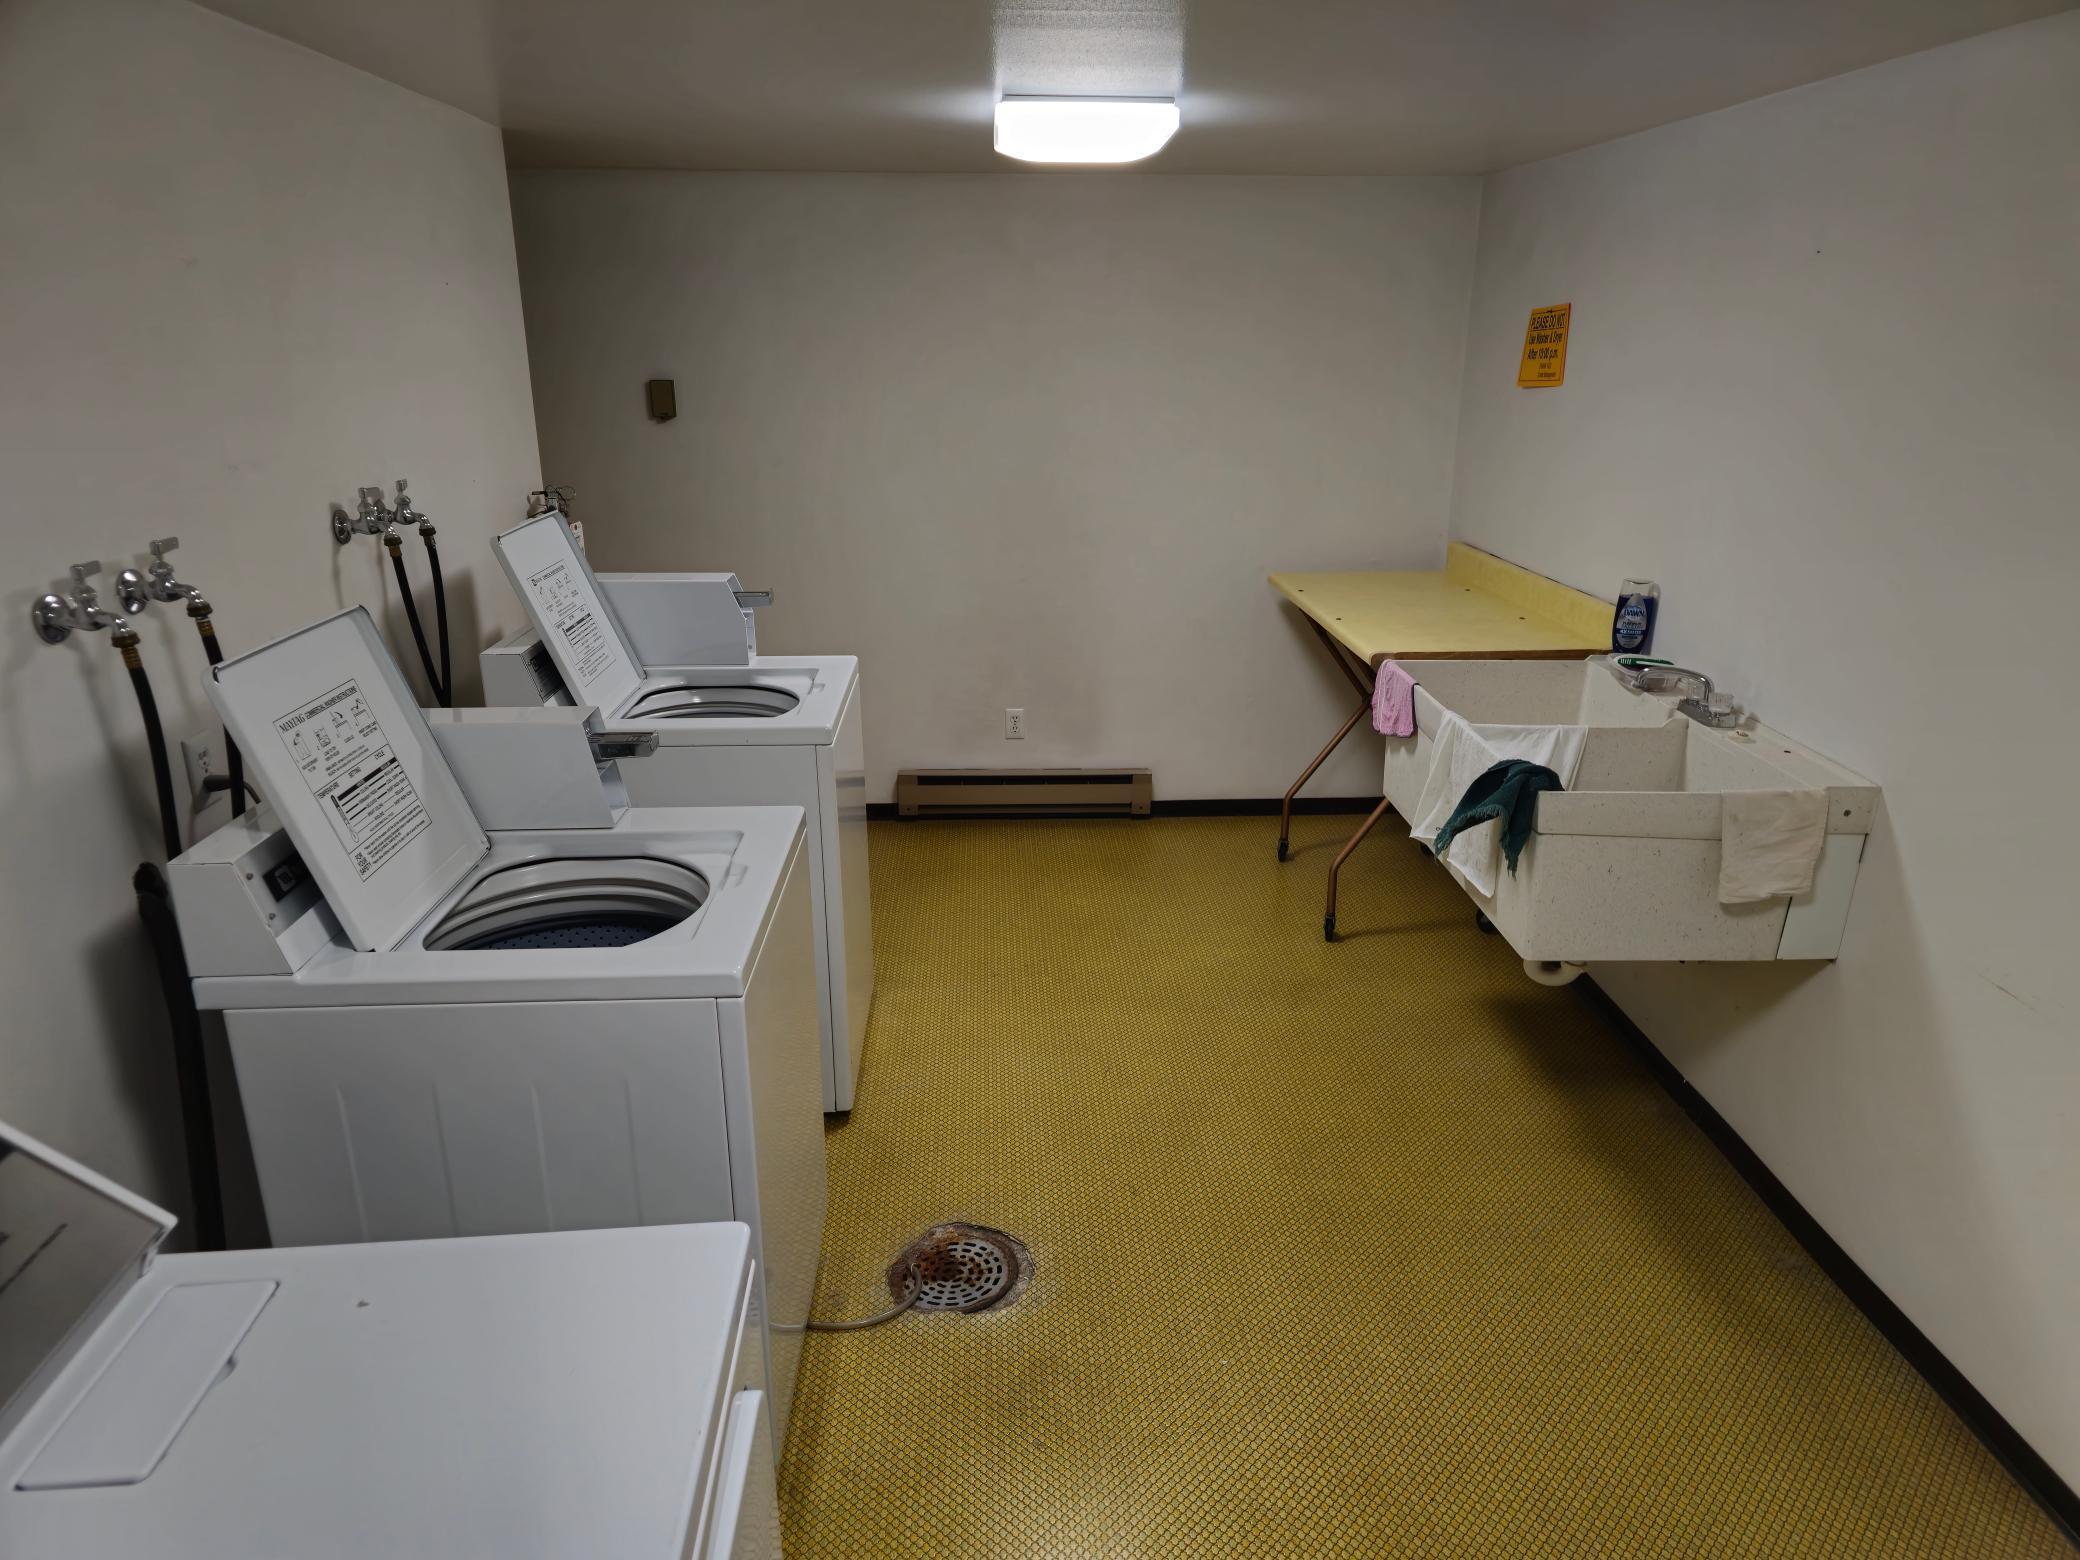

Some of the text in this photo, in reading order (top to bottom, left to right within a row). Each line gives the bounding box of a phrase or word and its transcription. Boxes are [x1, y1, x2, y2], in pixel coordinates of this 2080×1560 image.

[1532, 313, 1566, 330] PLEASE DO NOT
[1536, 333, 1550, 344] Washer
[1553, 330, 1563, 345] Dryer
[1528, 349, 1538, 360] After
[1624, 608, 1645, 617] DAWN
[279, 713, 306, 733] MAYTAG
[374, 750, 385, 760] CYCLE
[359, 862, 372, 875] SAFETY
